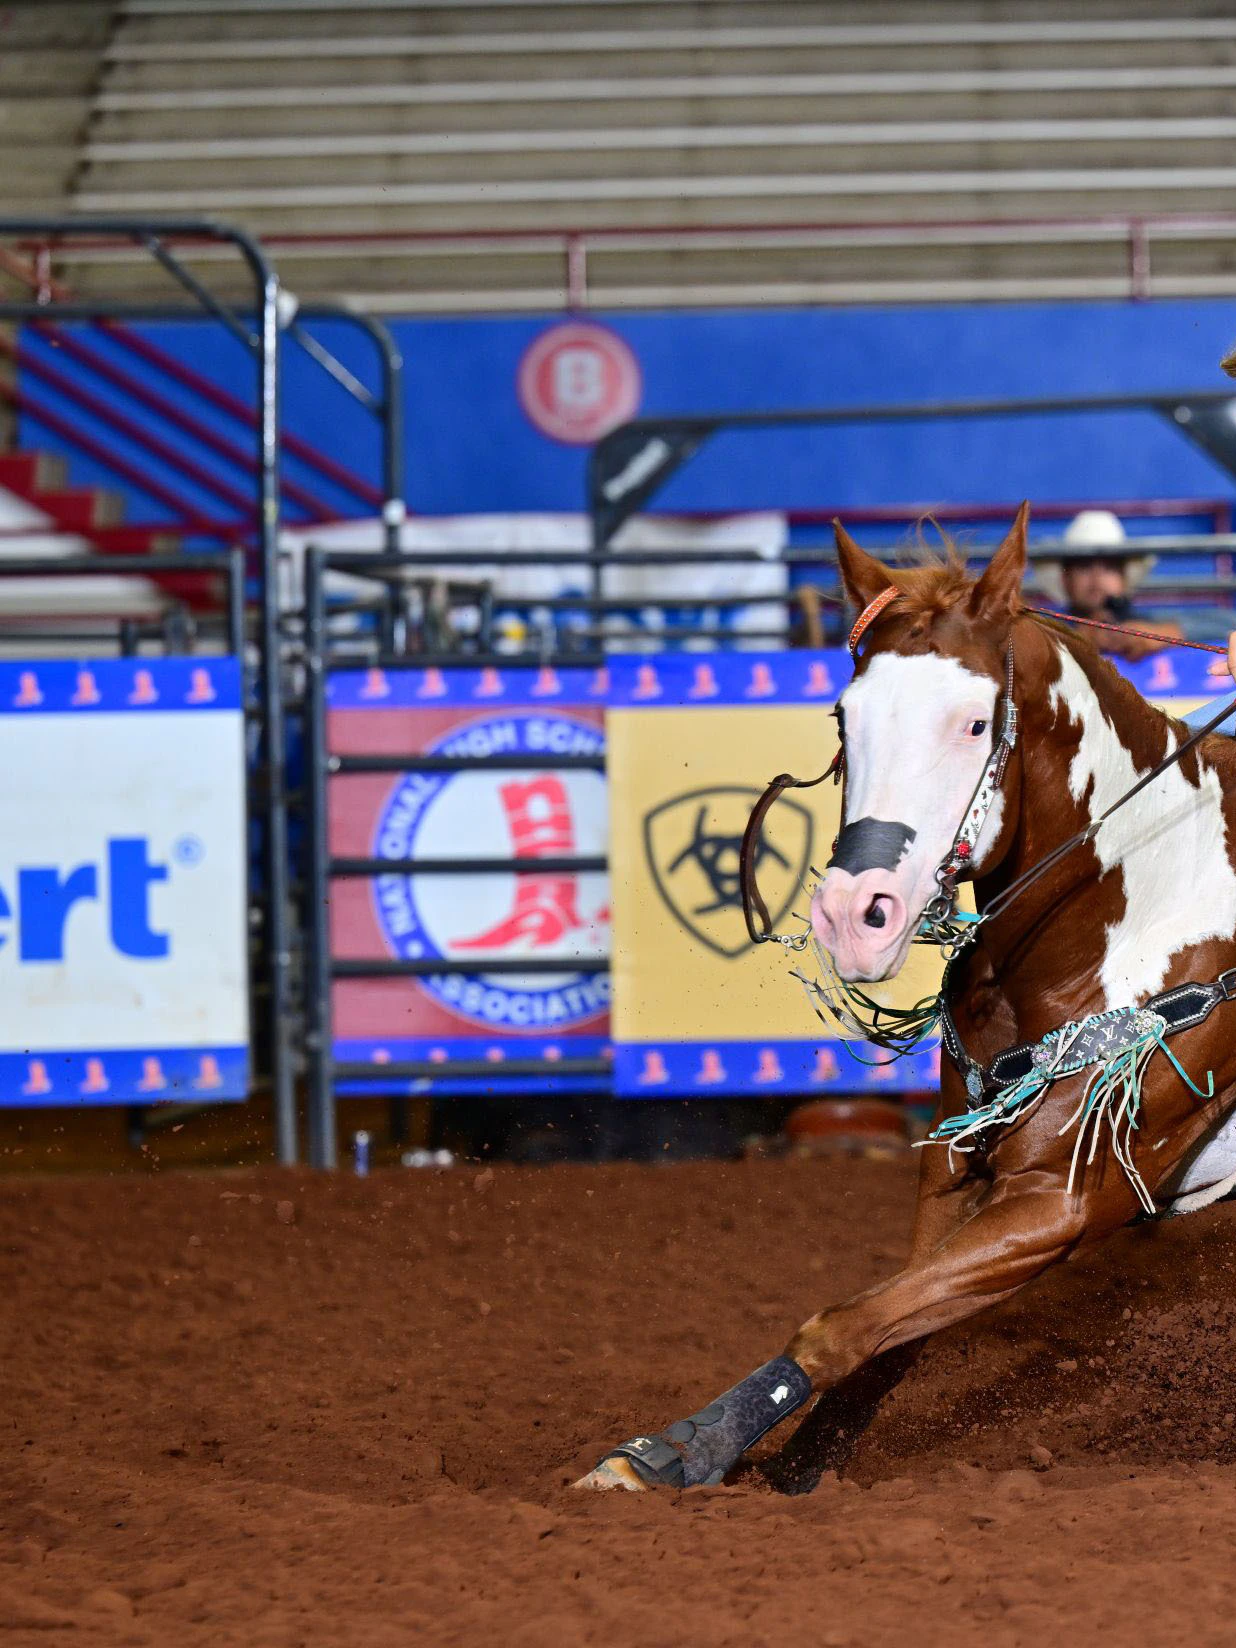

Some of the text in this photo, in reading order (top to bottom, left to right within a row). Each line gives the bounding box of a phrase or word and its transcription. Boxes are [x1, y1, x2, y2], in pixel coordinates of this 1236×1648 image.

[556, 350, 605, 406] B
[525, 718, 607, 758] SCH
[0, 836, 169, 962] rt
